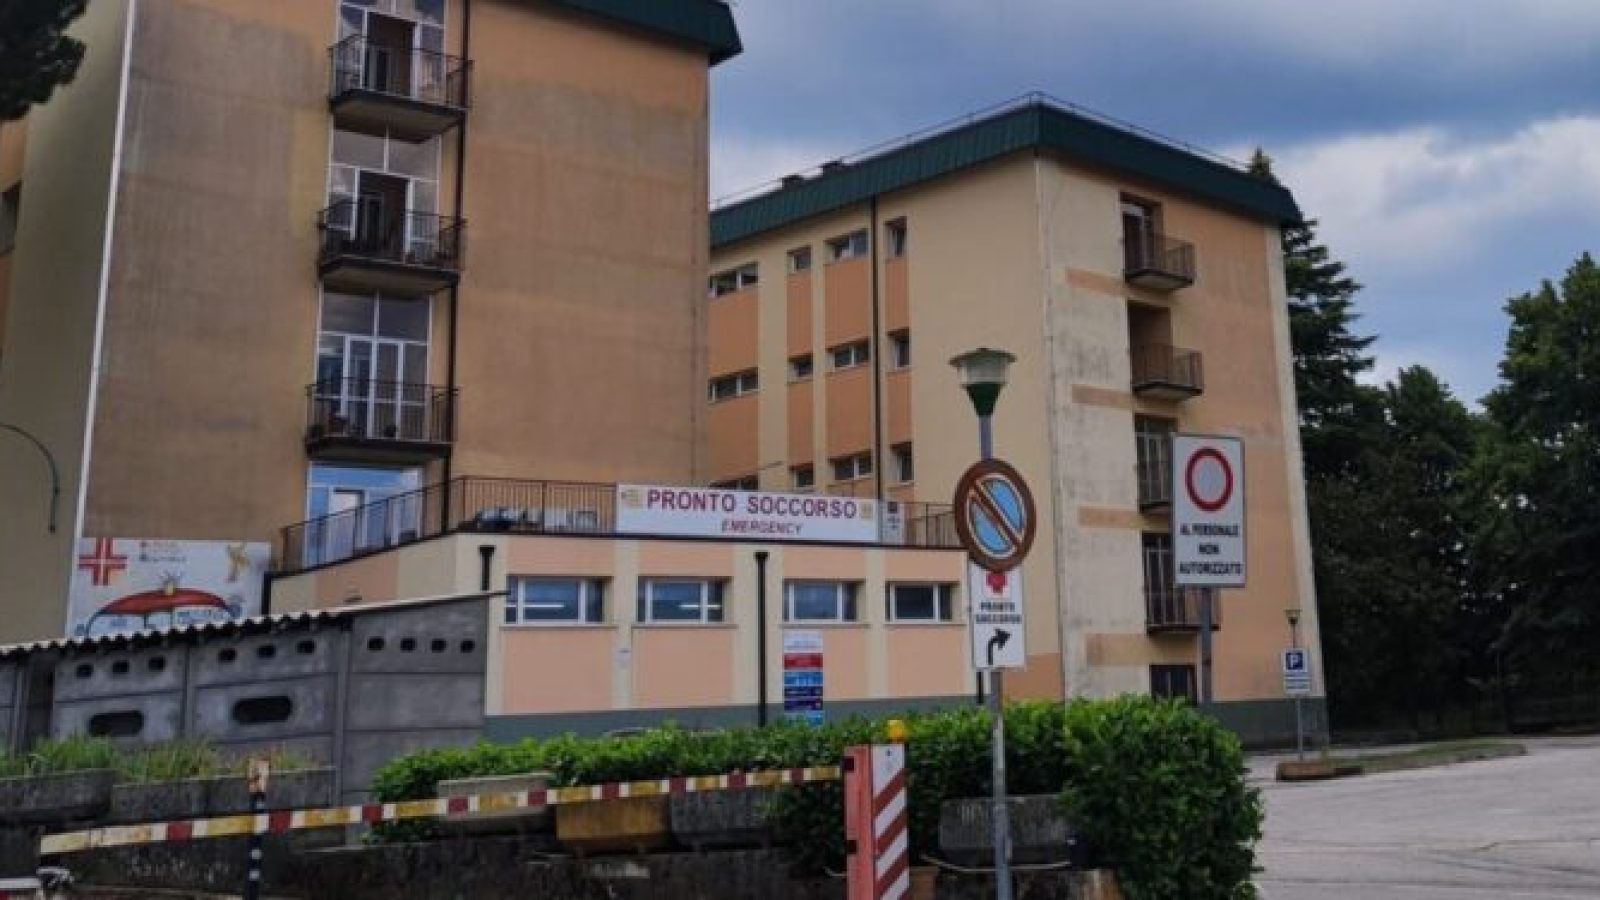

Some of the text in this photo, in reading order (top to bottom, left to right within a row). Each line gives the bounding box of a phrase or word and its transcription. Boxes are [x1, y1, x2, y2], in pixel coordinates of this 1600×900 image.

[646, 488, 857, 519] PRONTO SOCCORSO
[720, 520, 802, 536] EMERGENCY
[1191, 523, 1239, 537] PERSONALE
[1198, 544, 1220, 555] NON
[1179, 562, 1244, 576] AUTORIZZATO
